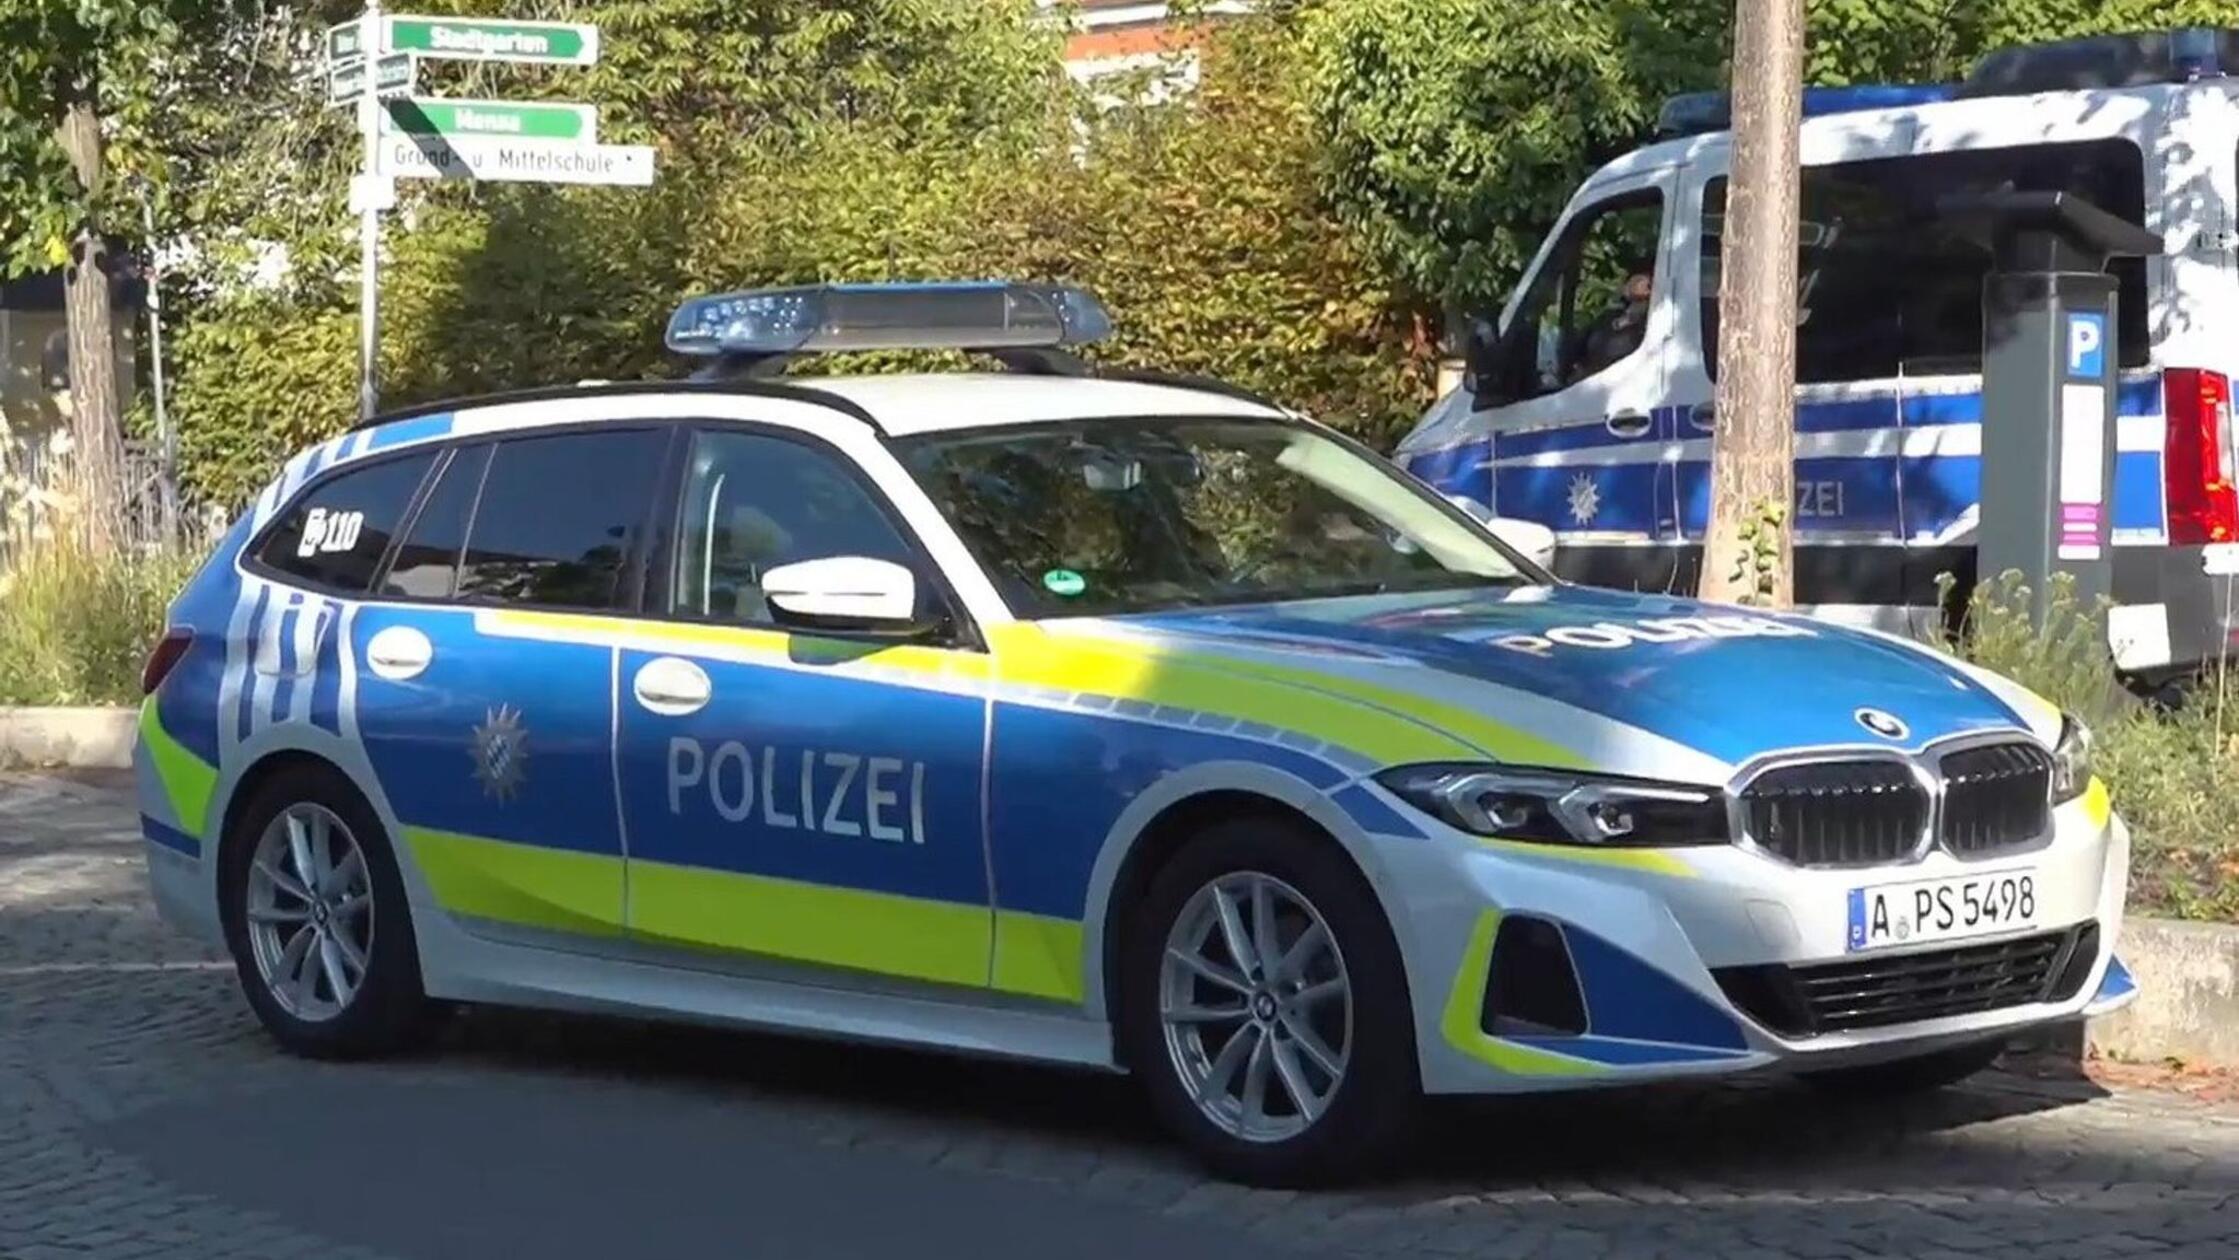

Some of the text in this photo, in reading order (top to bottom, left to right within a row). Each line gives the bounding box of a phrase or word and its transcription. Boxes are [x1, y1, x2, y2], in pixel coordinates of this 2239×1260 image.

[430, 26, 549, 56] Stadtgarten
[499, 150, 614, 173] Mittelschule
[2071, 319, 2100, 369] P
[320, 511, 364, 552] 110
[667, 736, 925, 844] POLIZEI
[1871, 876, 2036, 938] A PS 5498
